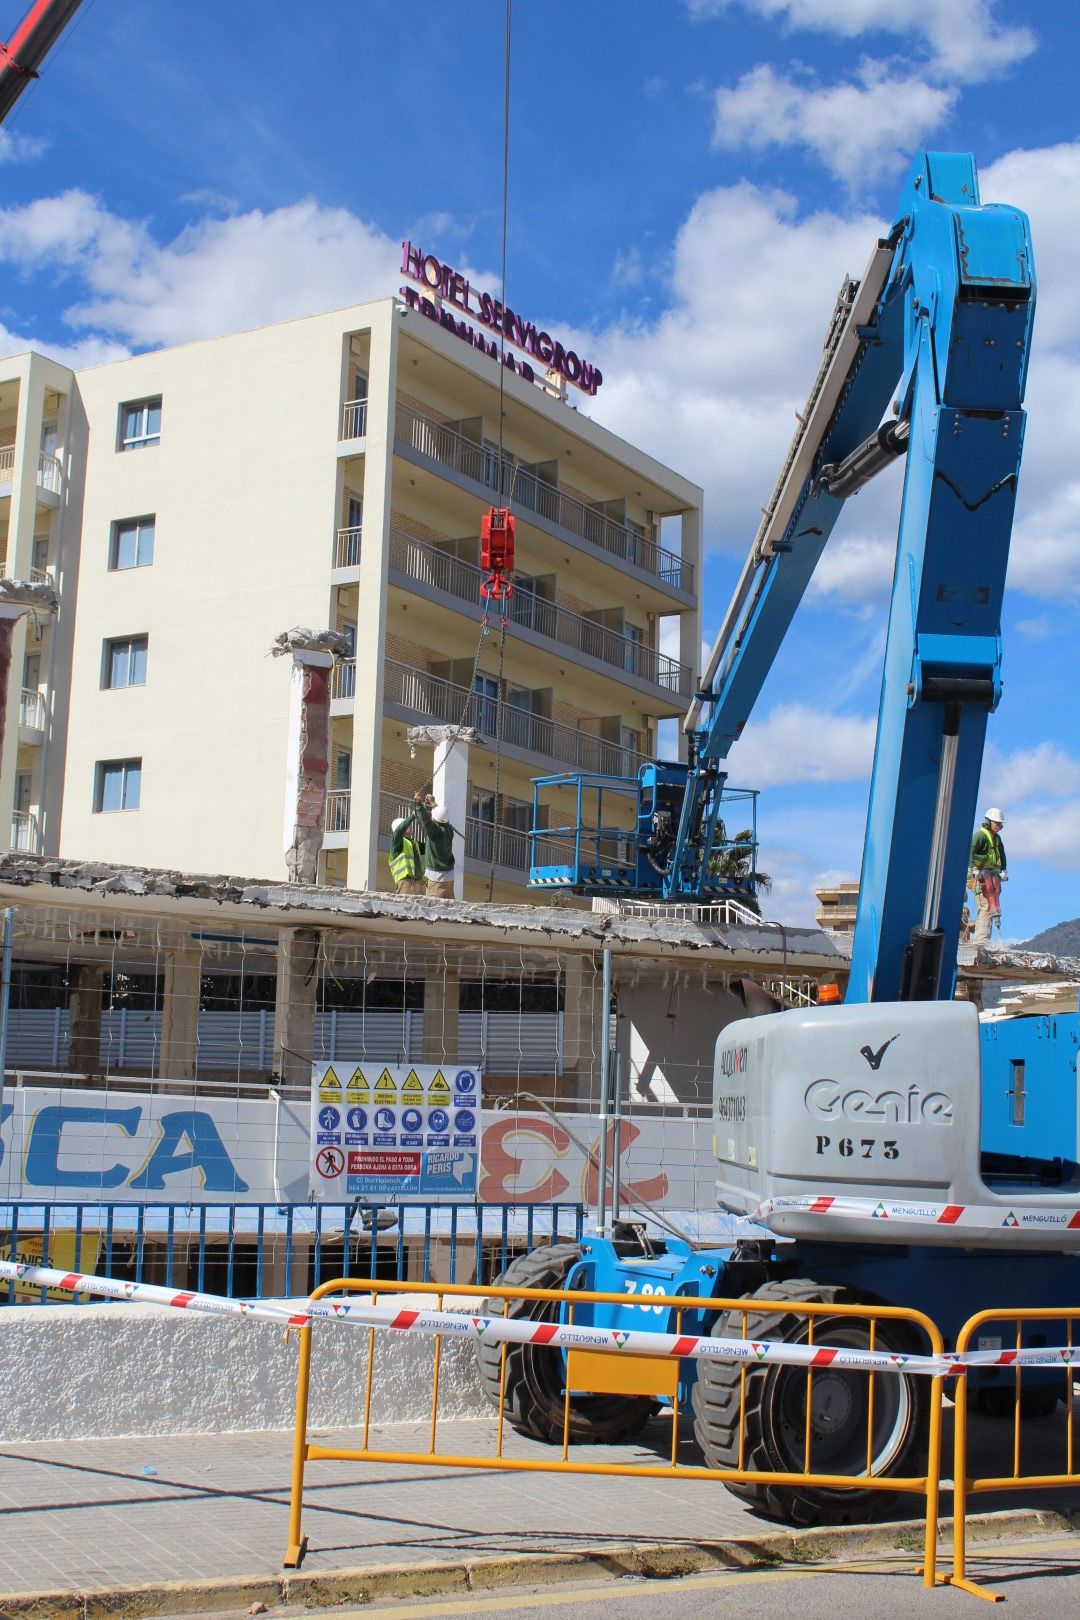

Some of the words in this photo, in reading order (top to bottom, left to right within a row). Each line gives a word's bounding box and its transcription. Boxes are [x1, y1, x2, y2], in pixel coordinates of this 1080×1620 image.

[400, 240, 475, 314] HOTEL
[477, 292, 603, 396] SERVIGROUP
[804, 1078, 953, 1126] Genie
[427, 1152, 460, 1164] RICARDO
[426, 1162, 452, 1175] PERIS
[891, 1206, 938, 1218] MENGUILLÓ
[1022, 1214, 1068, 1224] MENGUILLÓ
[420, 1319, 469, 1331] MENGUILLÓ
[559, 1332, 609, 1344] MENGUILLÓ
[699, 1344, 749, 1356] MENGUILLÓ
